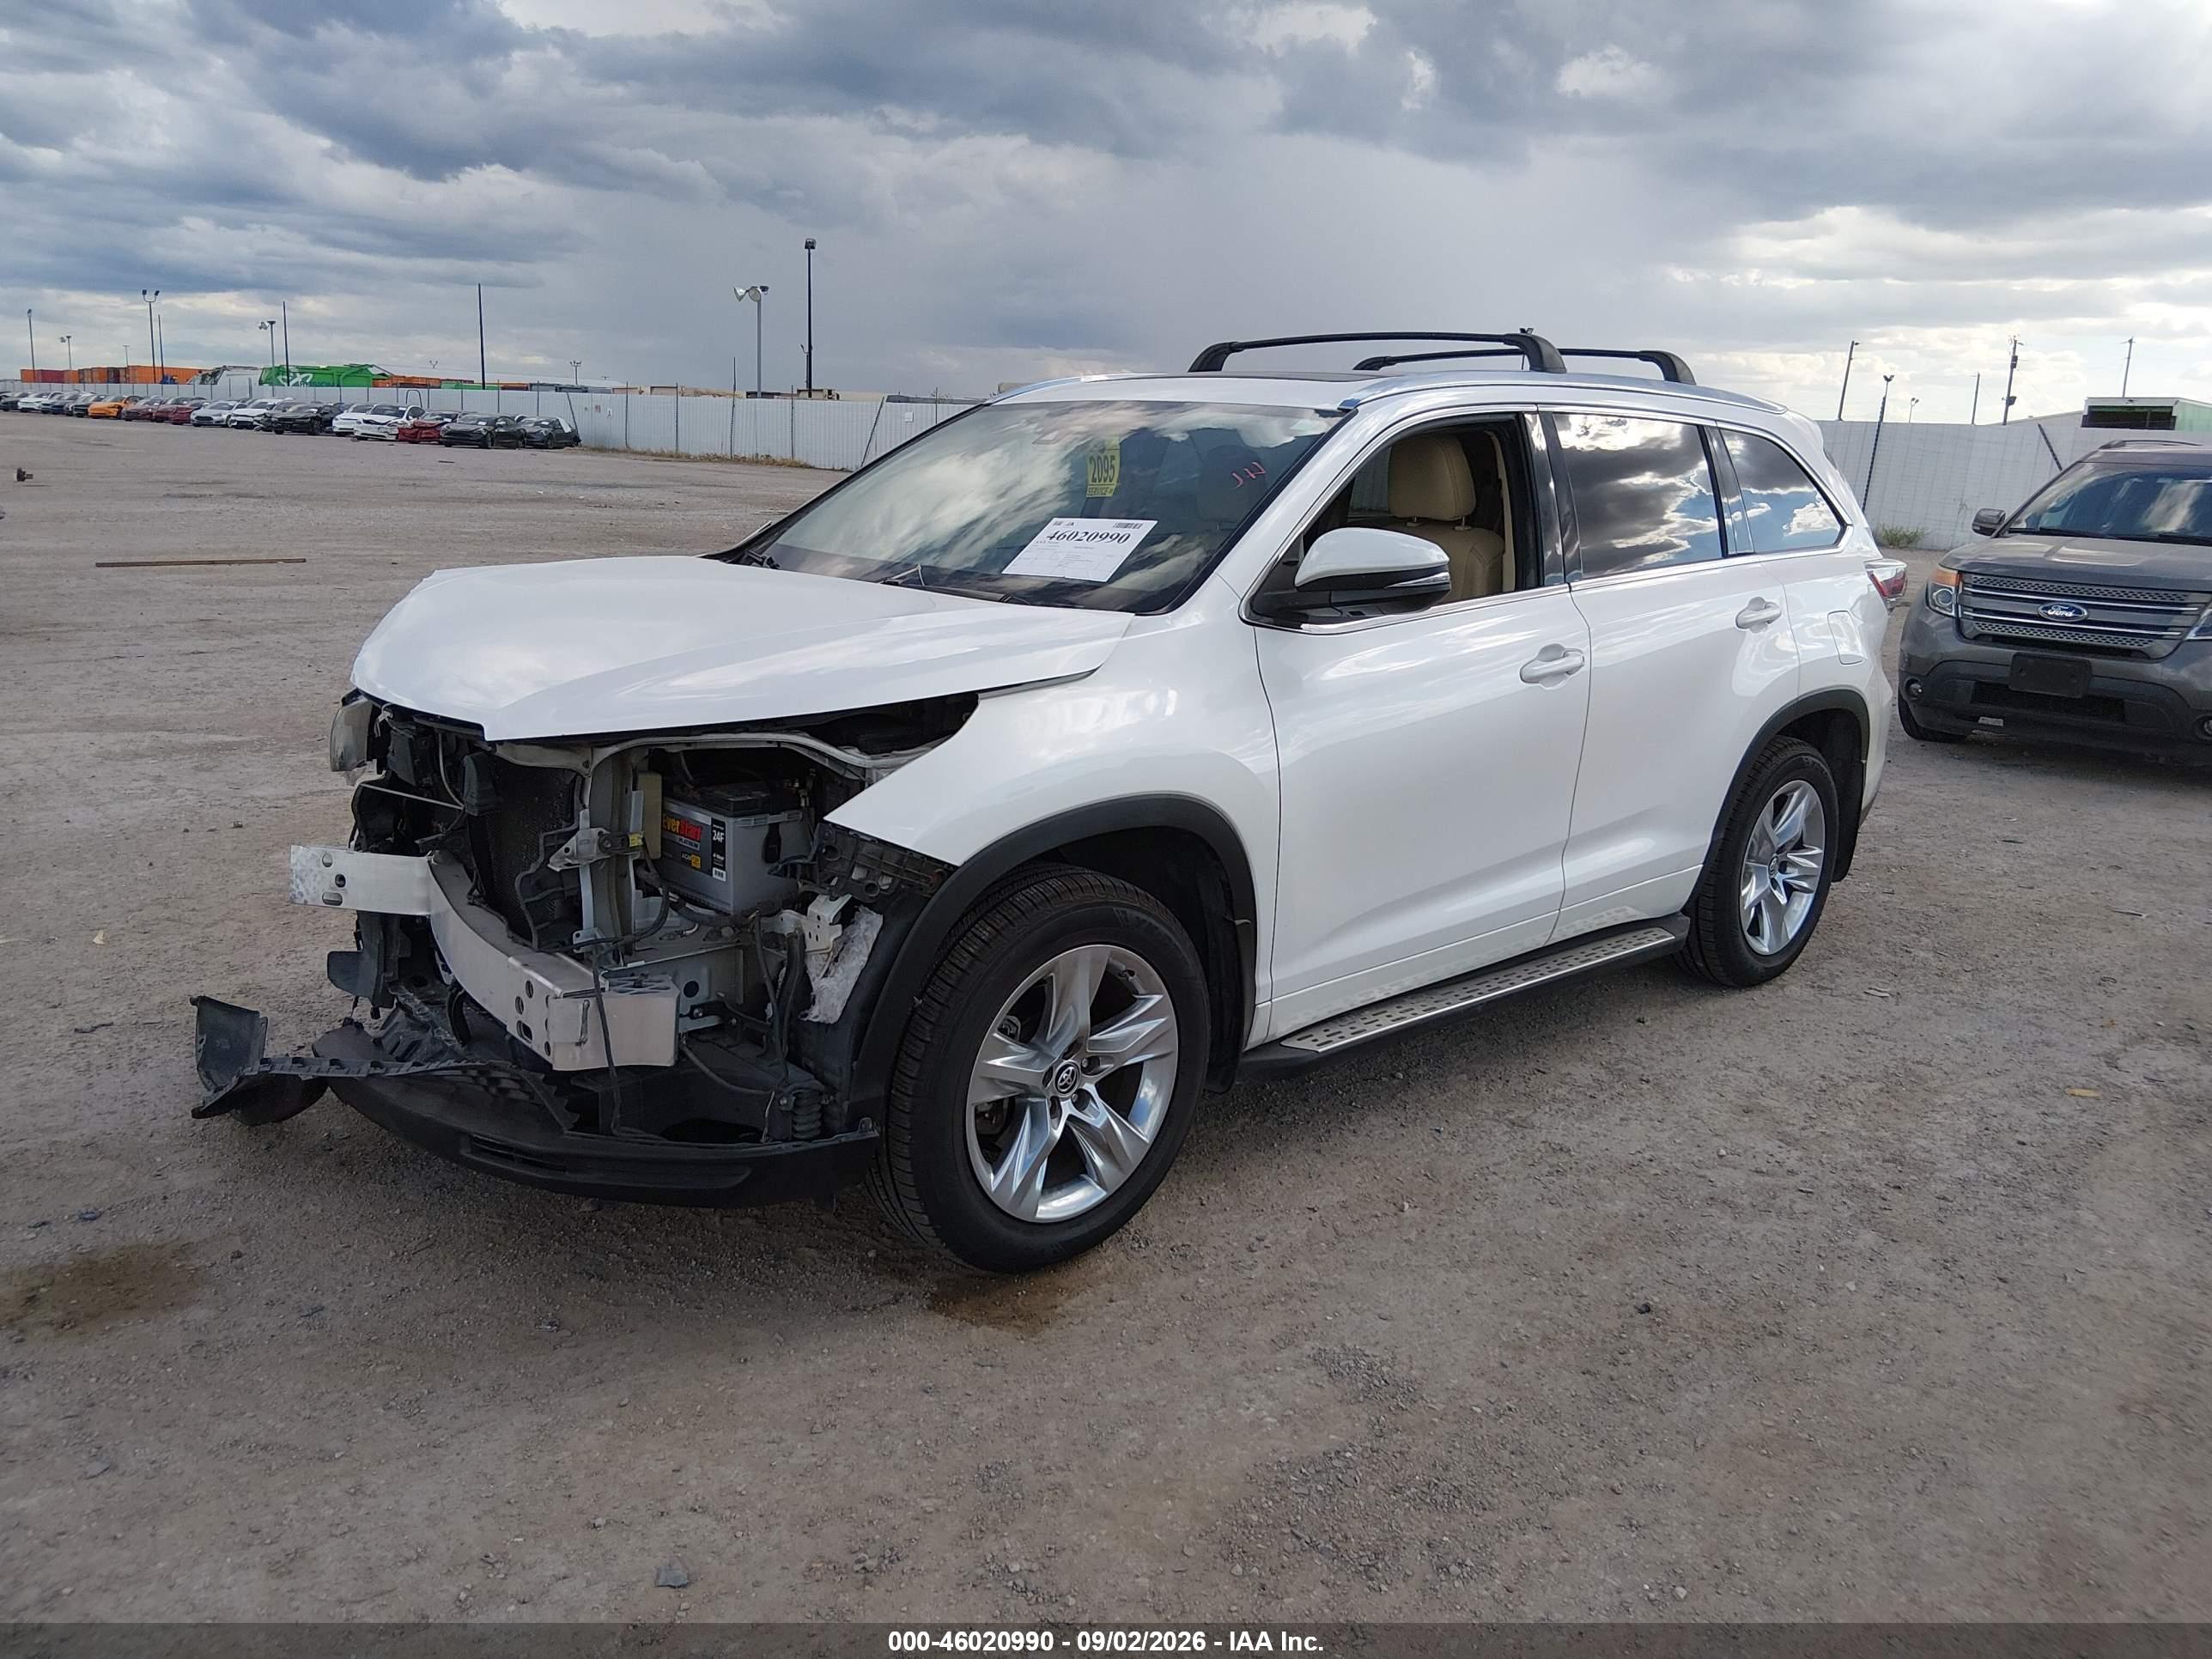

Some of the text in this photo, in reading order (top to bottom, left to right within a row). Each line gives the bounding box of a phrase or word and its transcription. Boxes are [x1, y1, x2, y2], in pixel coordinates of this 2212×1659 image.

[1089, 454, 1115, 483] 2095
[1046, 530, 1132, 544] 46020990
[2046, 605, 2076, 617] Ford
[712, 830, 725, 843] 24F
